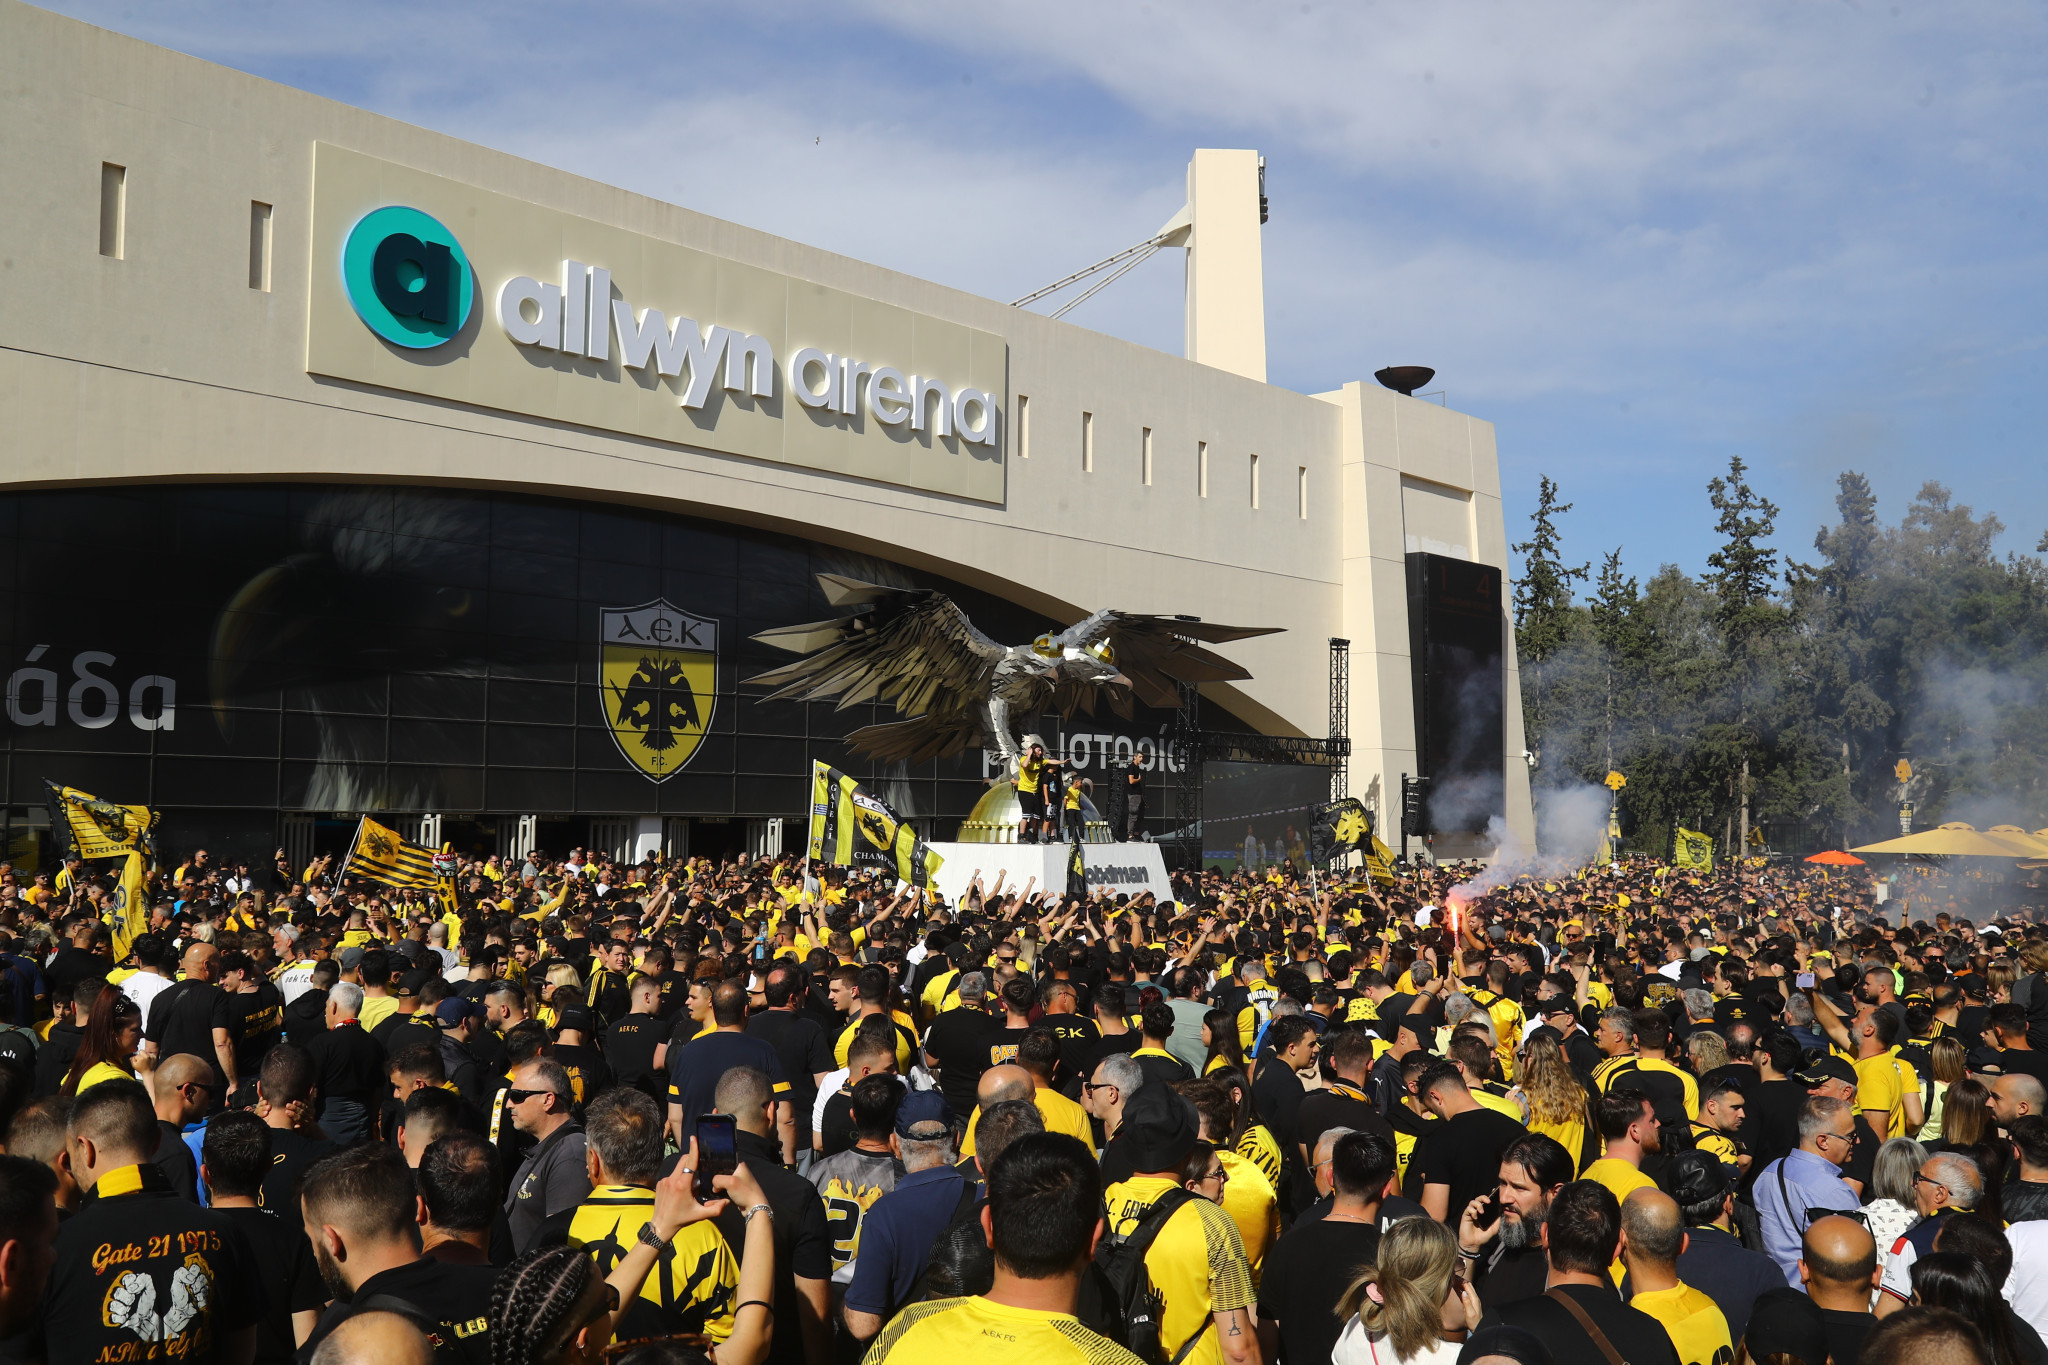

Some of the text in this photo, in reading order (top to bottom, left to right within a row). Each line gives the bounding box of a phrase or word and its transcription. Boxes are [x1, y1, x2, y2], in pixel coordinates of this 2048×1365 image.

[496, 259, 996, 447] allwyn arena
[5, 644, 176, 731] άδα
[827, 783, 838, 840] GATE 21
[492, 1108, 501, 1127] FILA
[91, 1230, 221, 1276] Gate 21 1975
[828, 1197, 867, 1263] 2
[1004, 1334, 1016, 1343] FC
